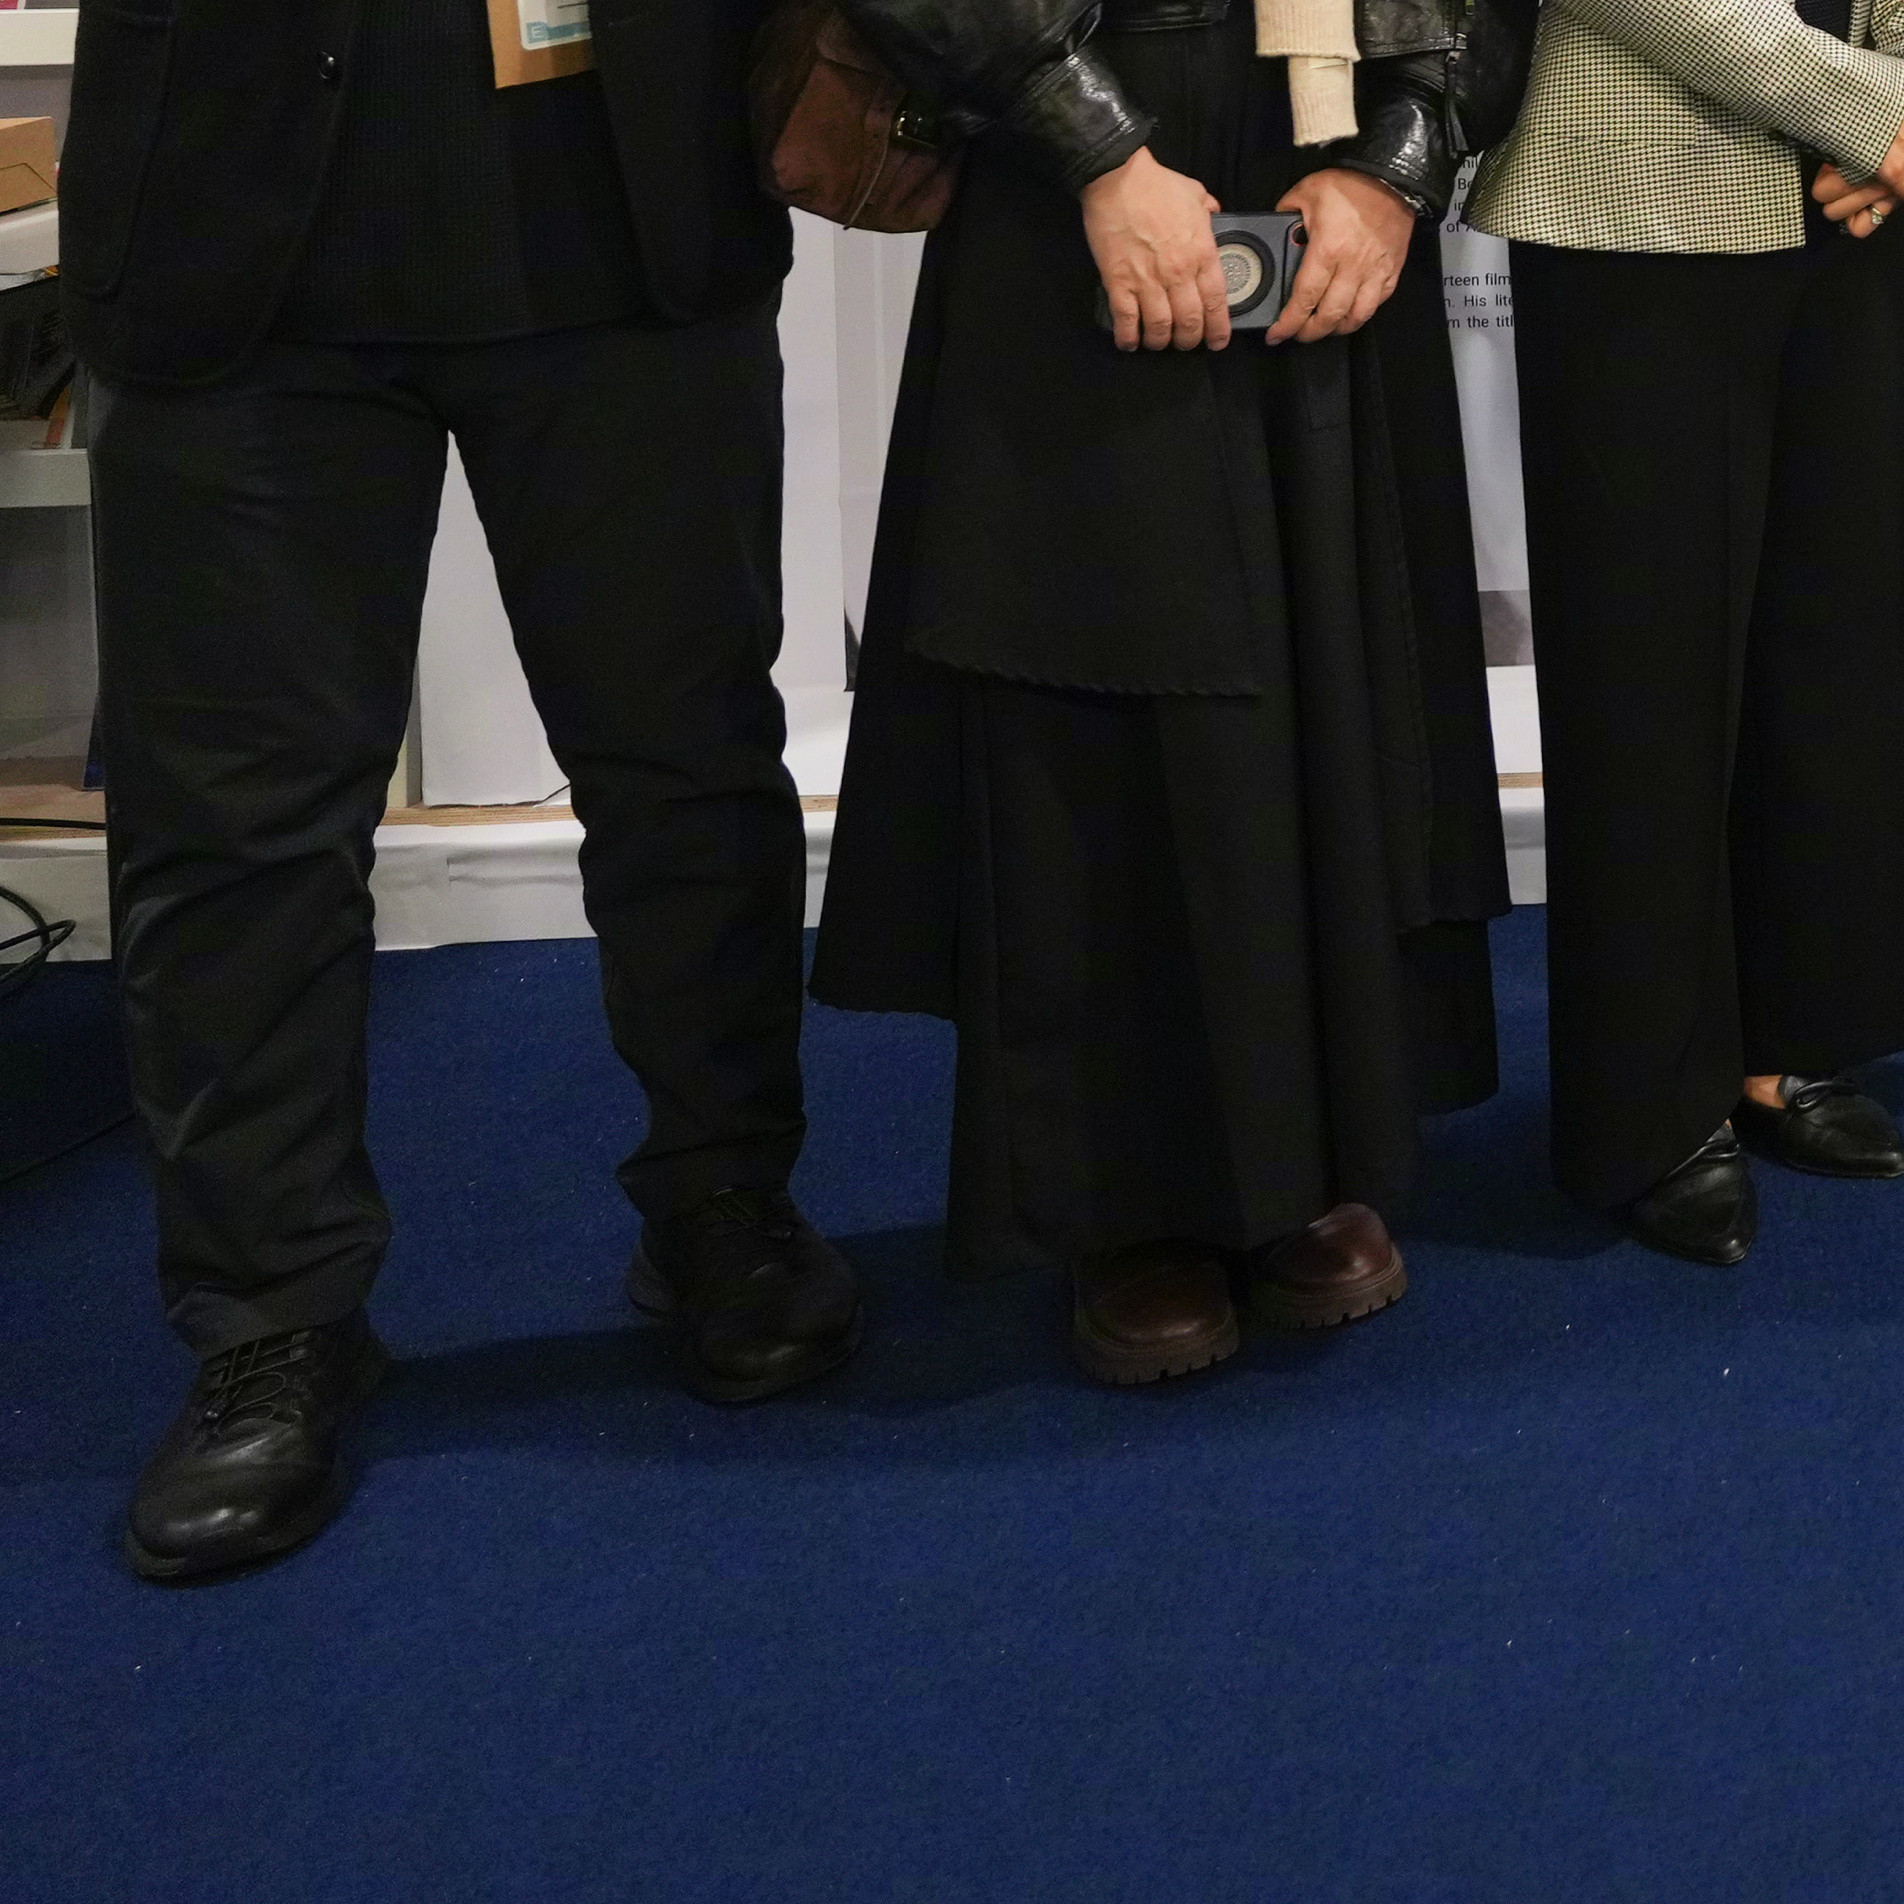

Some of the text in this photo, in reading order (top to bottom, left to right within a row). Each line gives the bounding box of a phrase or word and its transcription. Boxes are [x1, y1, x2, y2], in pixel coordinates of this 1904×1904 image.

[1446, 219, 1461, 233] of
[1444, 274, 1480, 287] rteen
[1463, 294, 1487, 307] His
[1448, 319, 1461, 328] m
[1466, 315, 1490, 328] the
